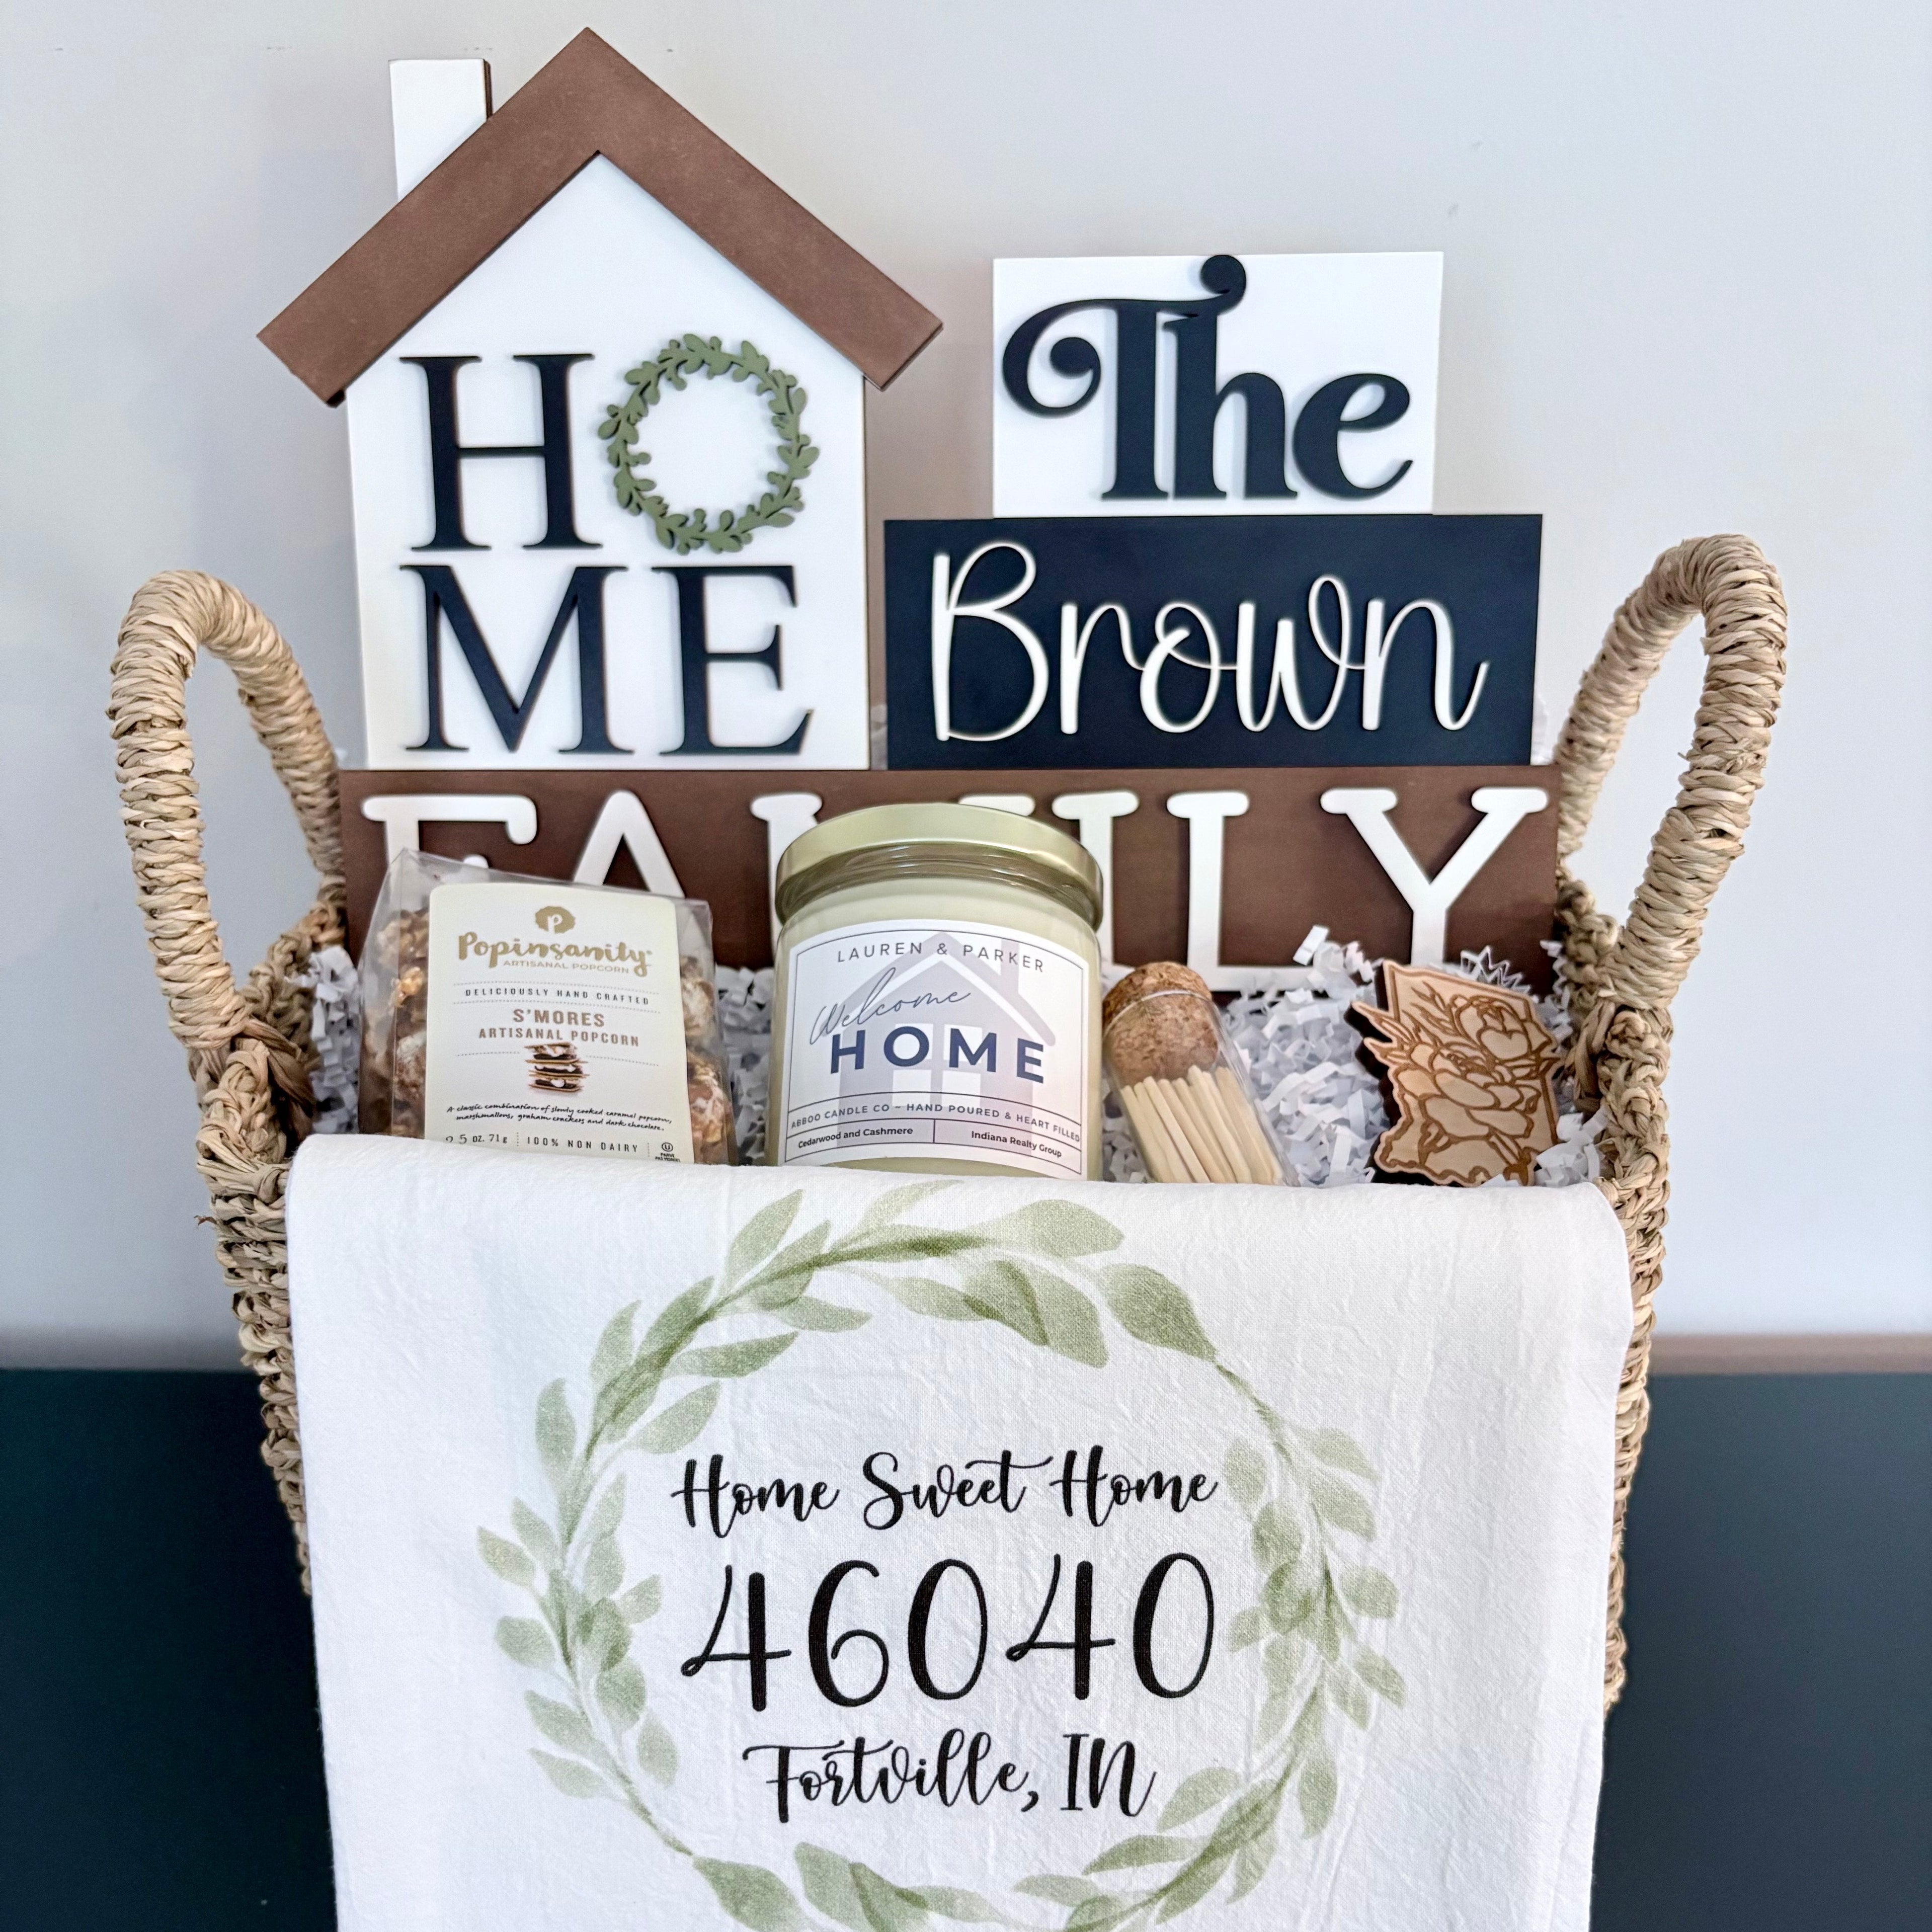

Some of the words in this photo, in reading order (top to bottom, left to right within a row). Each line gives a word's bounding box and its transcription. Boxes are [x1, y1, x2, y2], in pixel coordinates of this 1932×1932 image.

[1001, 254, 1413, 501] The
[932, 541, 1490, 743] Brown
[458, 932, 649, 978] Popinsanity
[503, 960, 569, 970] ARTISANAL
[572, 962, 629, 974] POPCORN
[837, 942, 923, 963] LAUREN
[936, 942, 948, 955] &
[963, 944, 1044, 973] PARKER
[465, 988, 549, 997] DELICIOUSLY
[557, 990, 588, 999] HAND
[596, 993, 649, 1005] CRAFTED
[809, 967, 972, 1045] Welcome
[513, 1009, 605, 1028] S'MORES
[478, 1027, 564, 1040] ARTISANAL
[571, 1030, 640, 1047] POPCORN
[830, 1025, 1044, 1084] HOME
[456, 1103, 483, 1111] classic
[540, 1105, 550, 1113] of
[551, 1105, 574, 1116] slowly
[577, 1107, 604, 1115] cooked
[606, 1111, 636, 1119] caramel
[518, 1113, 551, 1121] graham
[552, 1114, 585, 1124] crackers
[825, 1107, 868, 1120] CANDLE
[873, 1103, 890, 1112] CO
[906, 1103, 943, 1112] HAND
[948, 1104, 1000, 1118] POURED
[1005, 1112, 1011, 1120] &
[1016, 1114, 1050, 1130] HEART
[1053, 1124, 1080, 1142] FILLED
[527, 1136, 559, 1147] 100%
[568, 1140, 592, 1149] NON
[601, 1142, 638, 1153] DAIRY
[798, 1133, 842, 1149] Cedarwood
[843, 1129, 861, 1139] and
[862, 1127, 914, 1136] Cashmere
[971, 1131, 1008, 1143] Indiana
[1009, 1136, 1038, 1151] Realty
[1038, 1144, 1062, 1158] Group
[671, 1453, 840, 1538] Home
[862, 1448, 1054, 1530] Sweet
[1049, 1444, 1219, 1527] Home
[680, 1552, 1215, 1712] 46040
[742, 1727, 1039, 1824] Fortville,
[1060, 1732, 1157, 1818] IN
